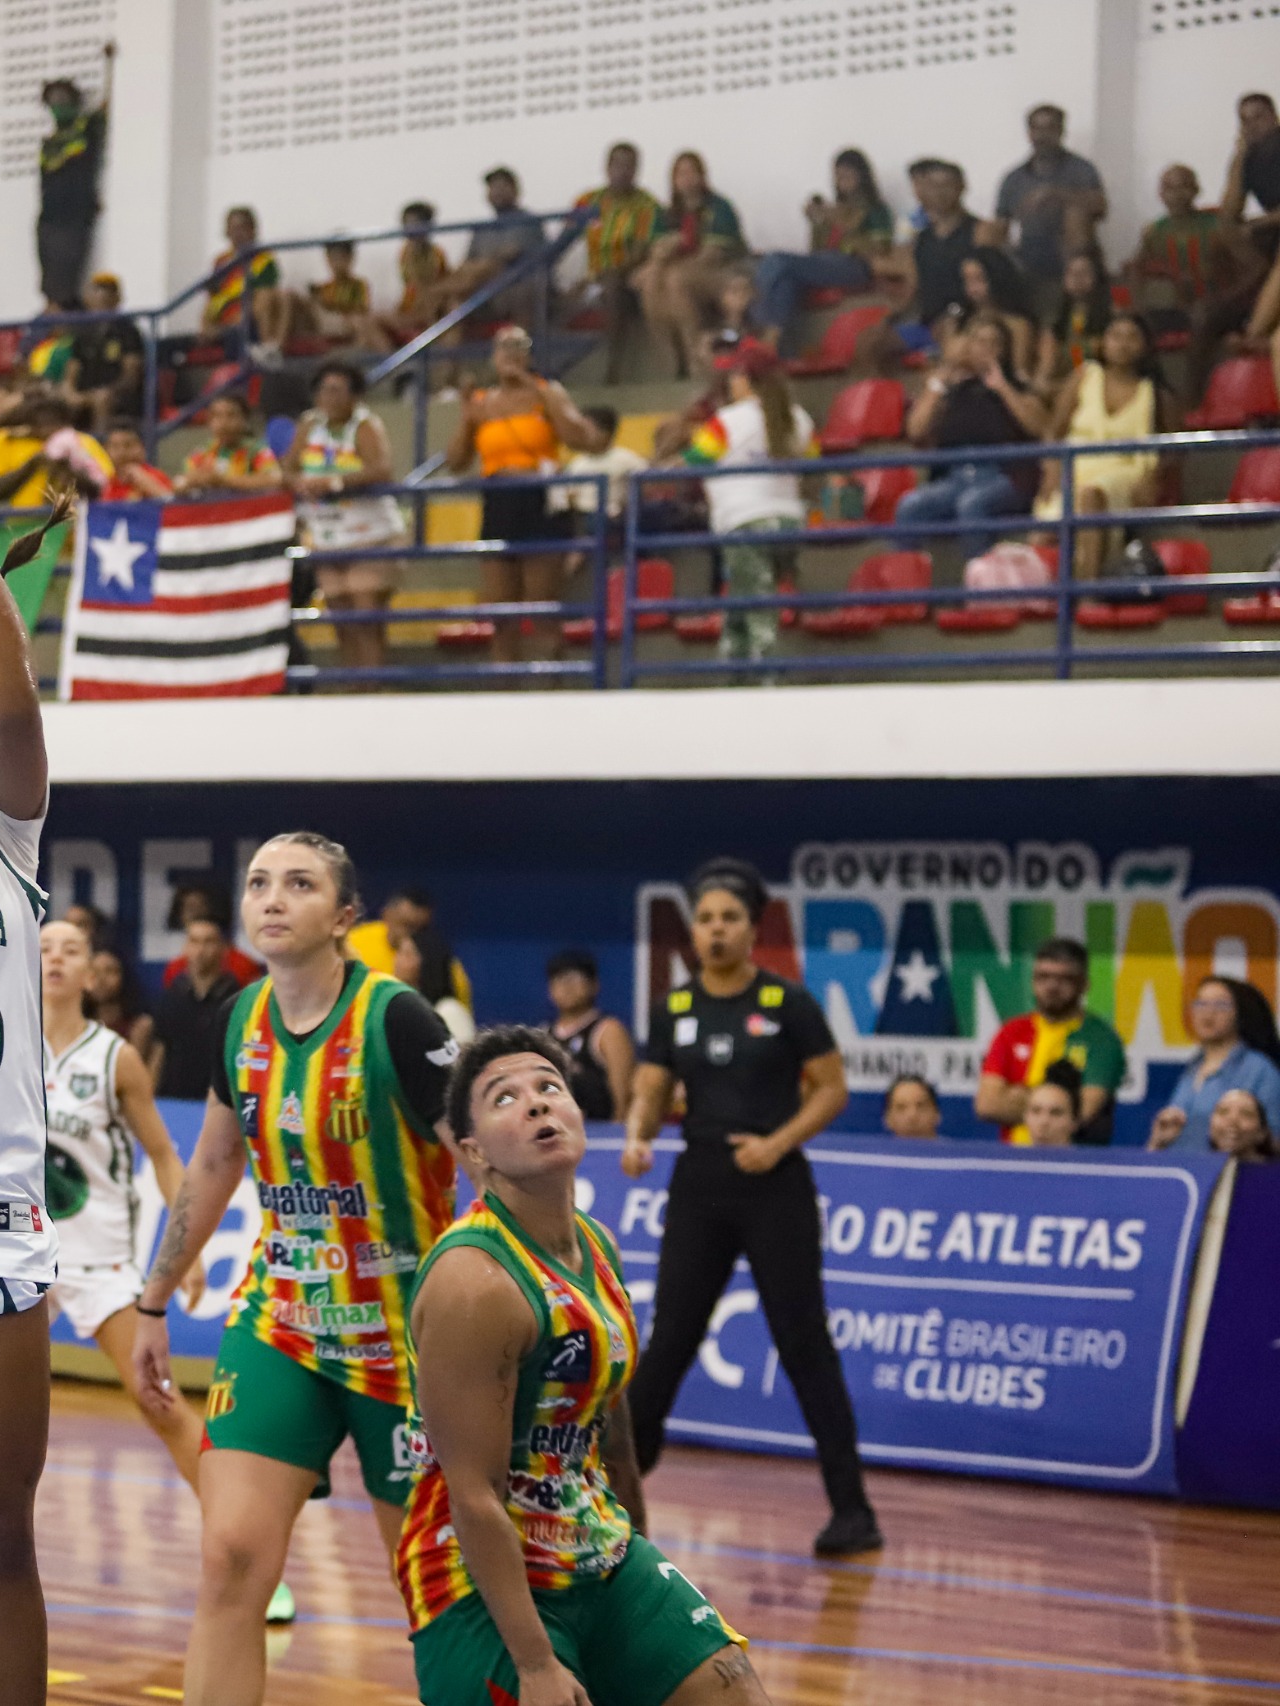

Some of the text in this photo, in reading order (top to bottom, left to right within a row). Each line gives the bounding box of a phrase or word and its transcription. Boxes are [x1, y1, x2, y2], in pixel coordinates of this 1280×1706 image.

[802, 853, 1087, 889] GOVERNO DO
[870, 1208, 937, 1261] DE
[938, 1212, 1146, 1271] ATLETAS
[827, 1307, 1127, 1370] OMITÊ BRASILEIRO
[903, 1362, 1048, 1411] CLUBES
